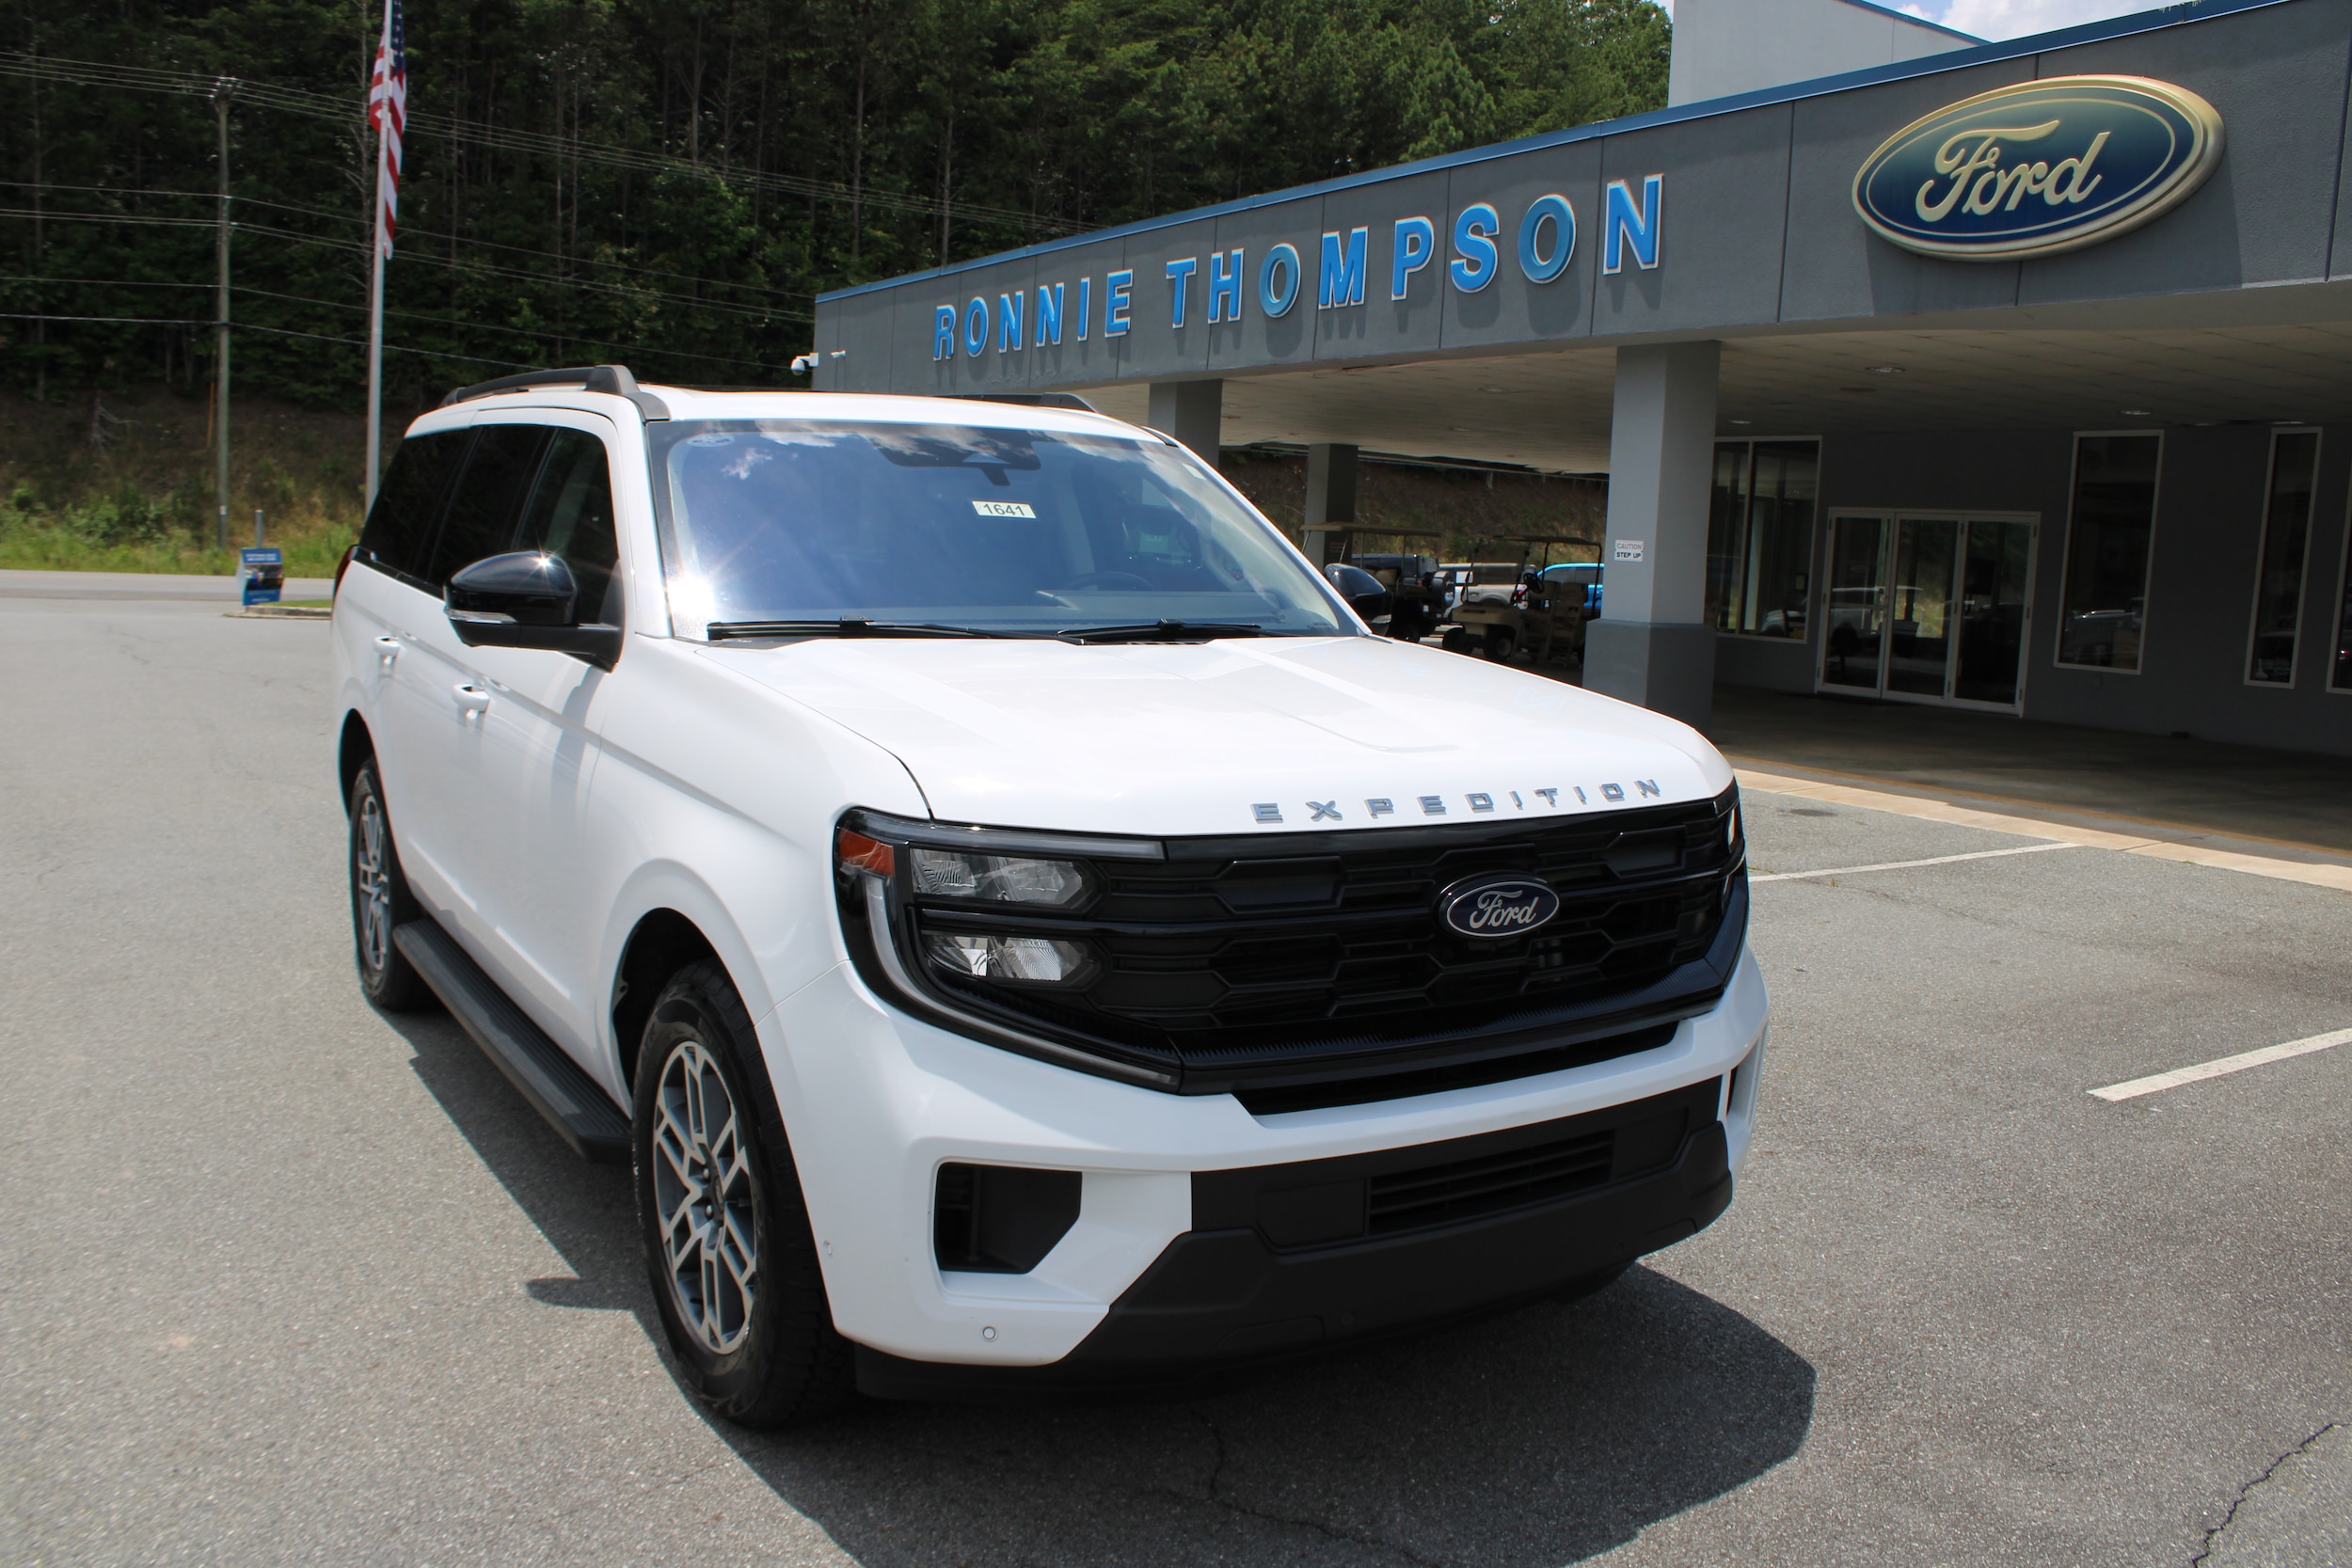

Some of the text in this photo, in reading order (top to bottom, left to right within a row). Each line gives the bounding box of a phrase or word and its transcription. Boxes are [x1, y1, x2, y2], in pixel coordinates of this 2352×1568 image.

[1915, 119, 2111, 222] Ford
[933, 173, 1663, 361] RONNIE THOMPSON
[983, 503, 1025, 516] 1641
[1250, 779, 1661, 823] EXPEDITION
[1469, 890, 1539, 929] Ford
